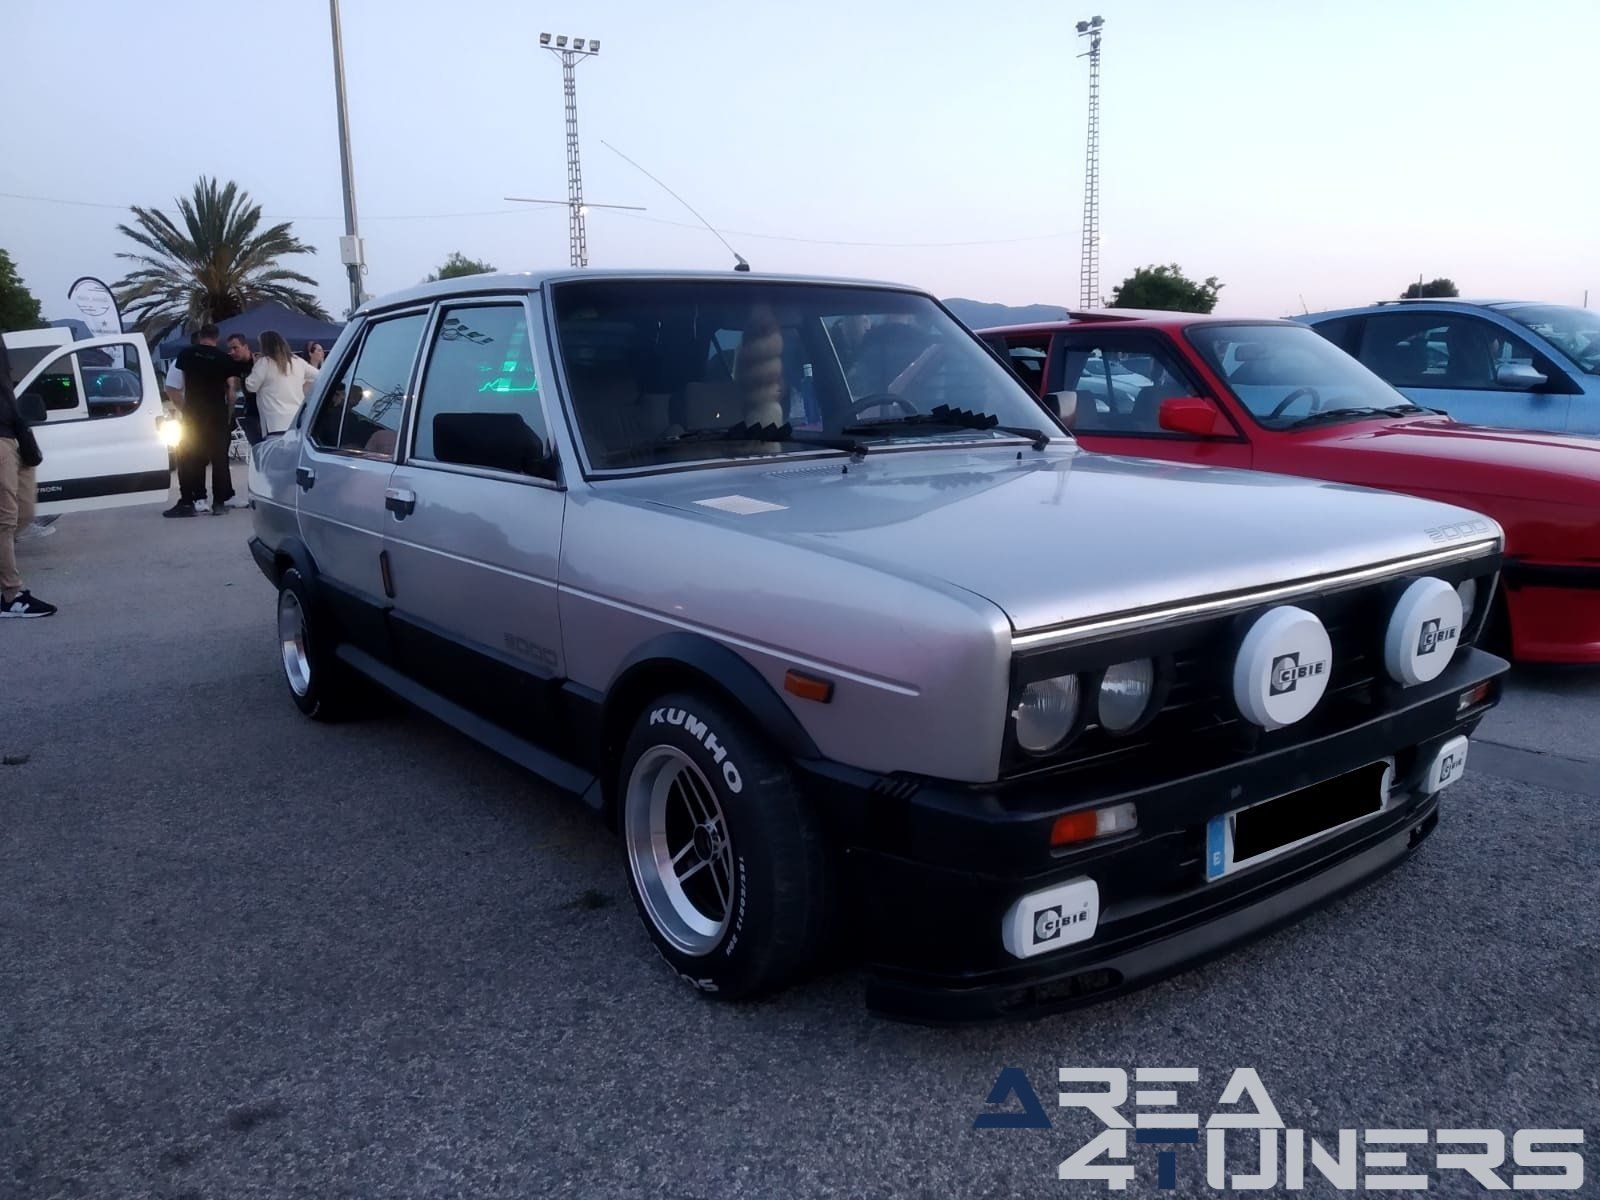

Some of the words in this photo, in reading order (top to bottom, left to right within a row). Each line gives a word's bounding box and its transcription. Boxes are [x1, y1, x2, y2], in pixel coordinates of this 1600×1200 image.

[1426, 628, 1456, 644] CIBIE
[1281, 662, 1323, 682] CIBIE
[650, 707, 743, 793] KUMHO
[1213, 851, 1221, 866] E
[1044, 911, 1087, 931] CIBIE
